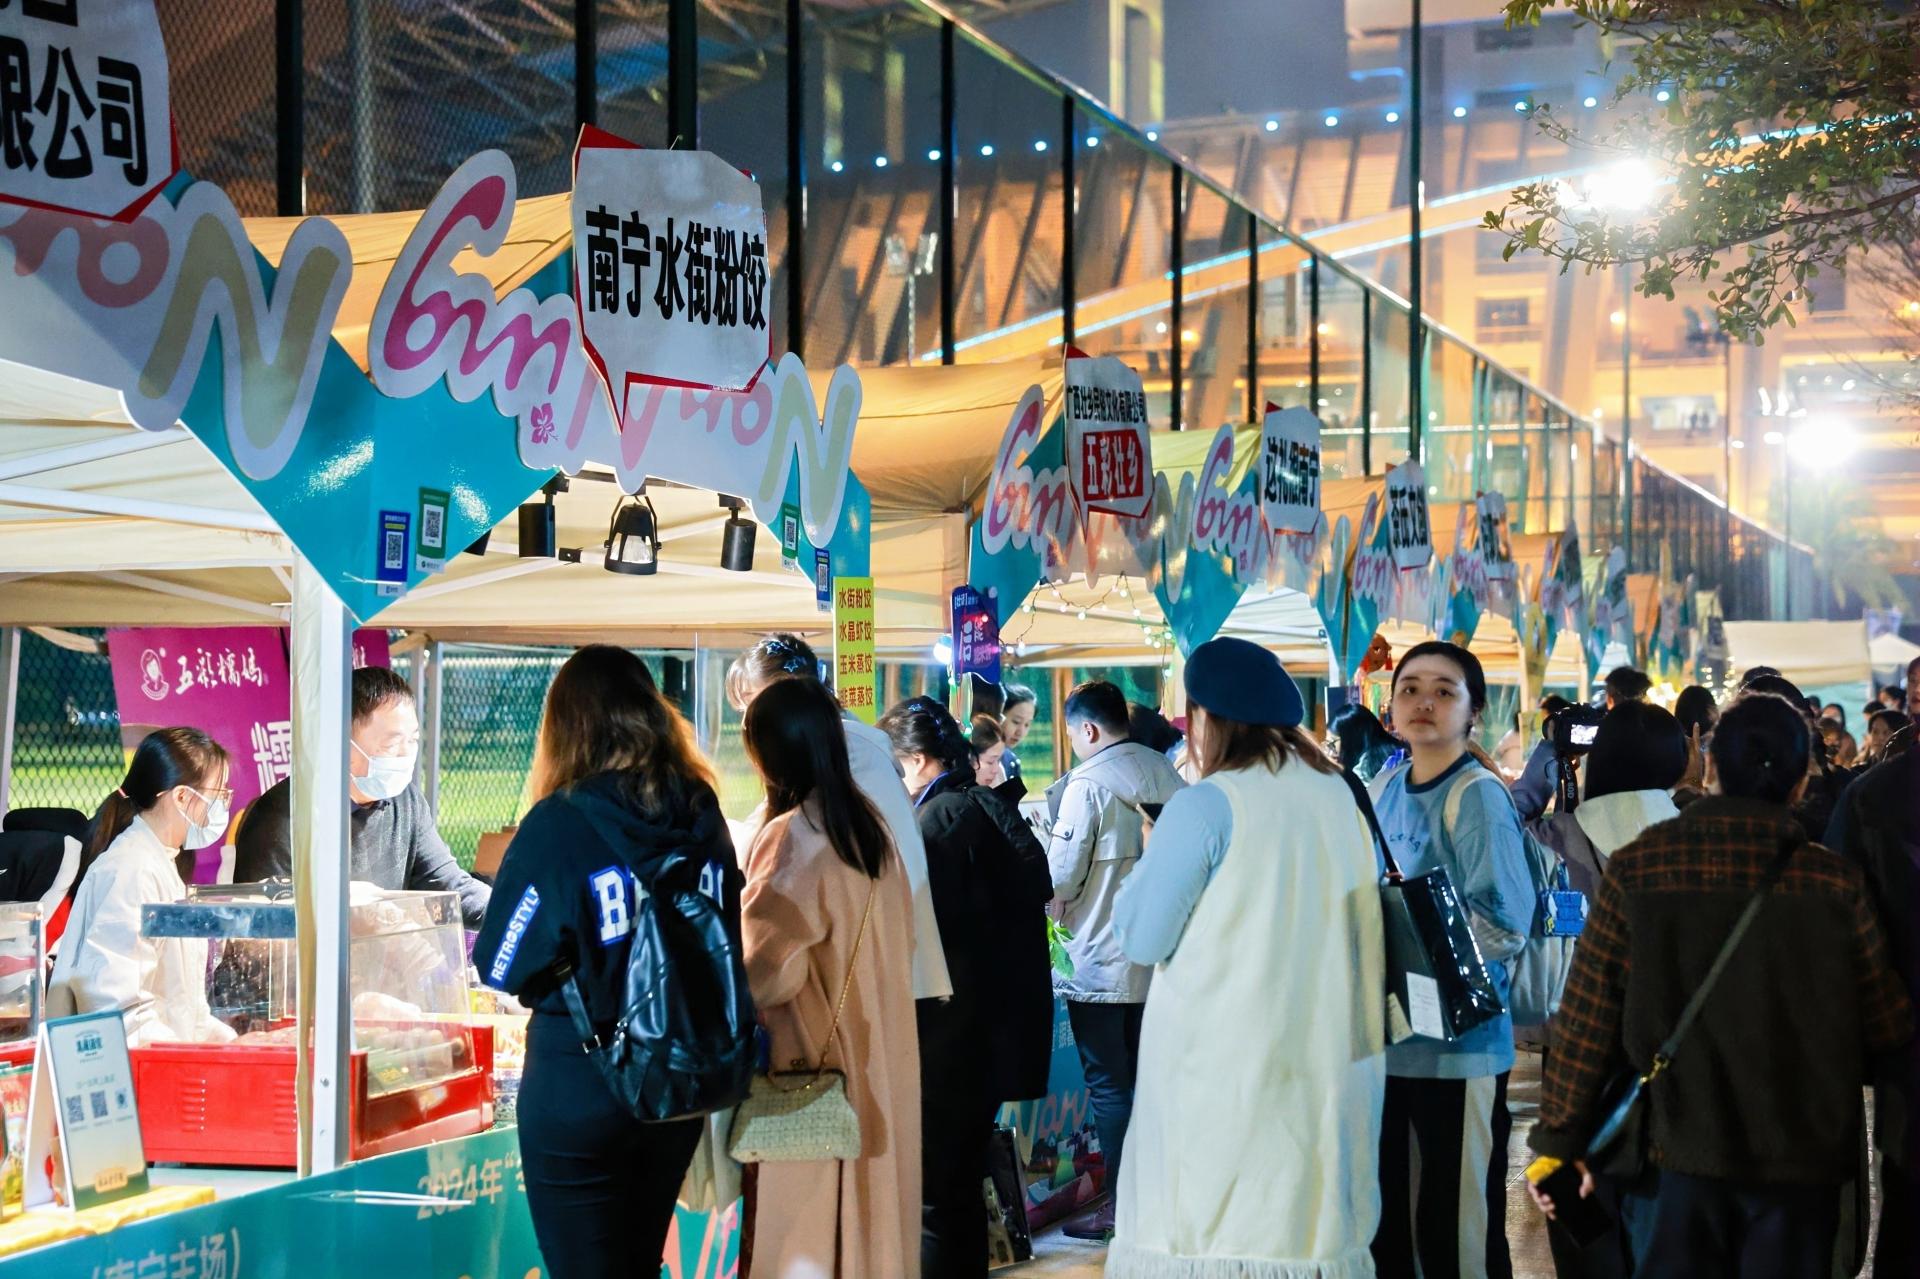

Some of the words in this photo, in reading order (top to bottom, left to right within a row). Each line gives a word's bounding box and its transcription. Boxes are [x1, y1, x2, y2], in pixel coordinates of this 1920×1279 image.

[584, 204, 767, 332] 南宁水街粉饺
[1085, 434, 1139, 496] 五彩壮乡
[839, 587, 872, 609] 水街粉饺
[839, 621, 872, 642] 水晶虾饺
[840, 653, 873, 675] 玉米蒸饺
